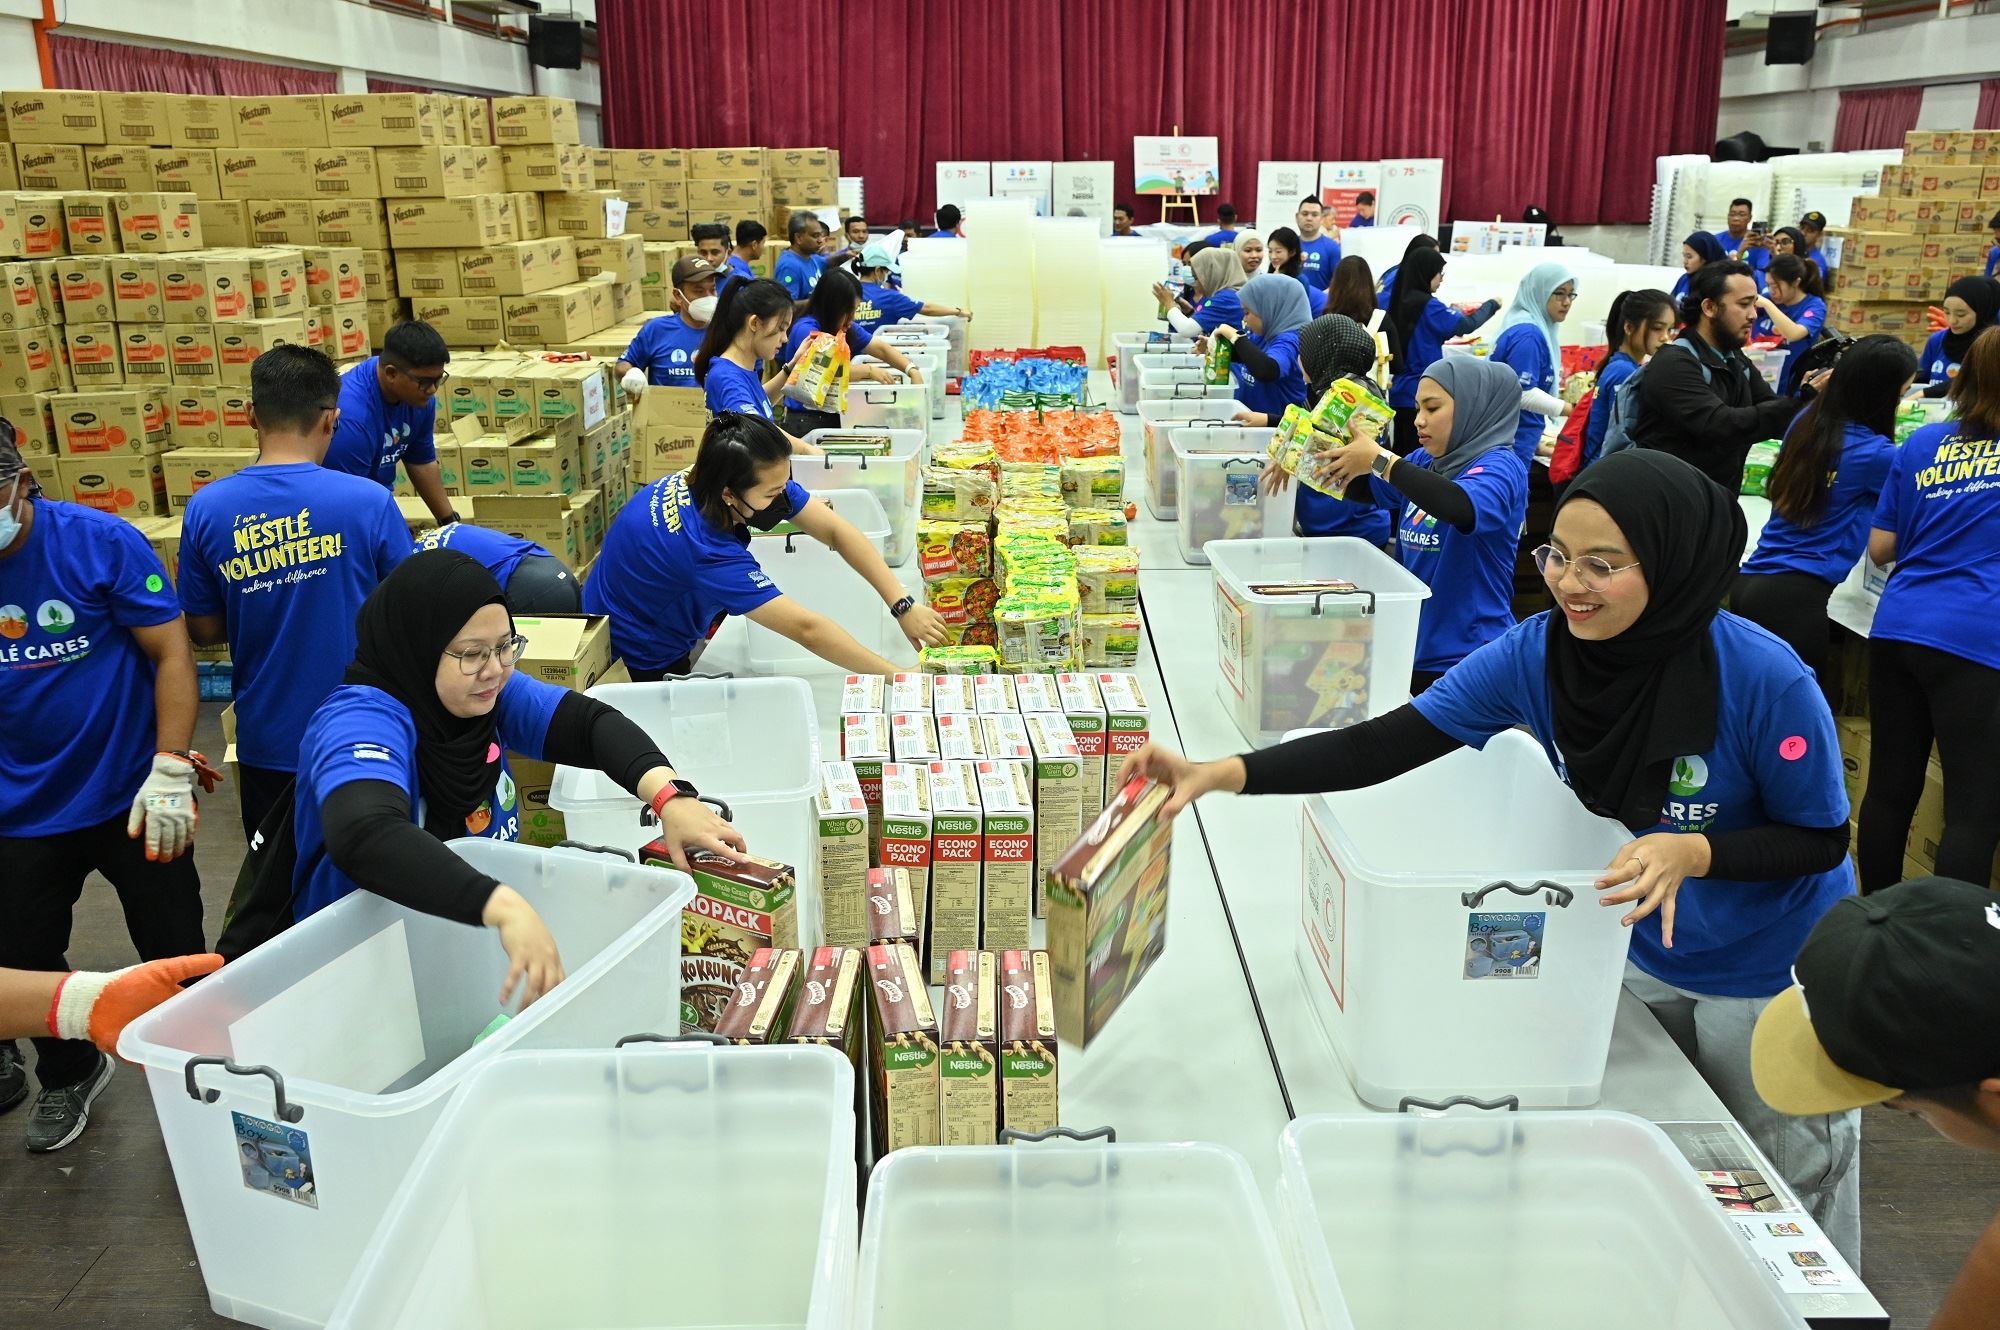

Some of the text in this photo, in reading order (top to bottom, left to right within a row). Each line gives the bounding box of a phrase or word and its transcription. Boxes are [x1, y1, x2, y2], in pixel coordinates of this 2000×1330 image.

[669, 368, 695, 376] NESTL
[655, 436, 695, 456] Nestum
[233, 515, 241, 527] I
[243, 515, 257, 523] am
[234, 508, 311, 553] NESTLÉ
[219, 533, 342, 583] VOLUNTEER!
[242, 580, 274, 594] making
[285, 567, 327, 584] difference
[24, 635, 90, 660] CARES
[1788, 741, 1796, 752] P
[1662, 801, 1719, 821] RES
[887, 844, 926, 853] ECONO
[938, 840, 977, 849] ECONO
[990, 840, 1028, 849] ECONO
[891, 854, 920, 863] PACK
[942, 850, 972, 858] PACK
[994, 850, 1023, 858] PACK
[712, 881, 749, 897] Whole Grain
[1470, 923, 1501, 933] Box
[240, 1115, 283, 1135] TOYOGO
